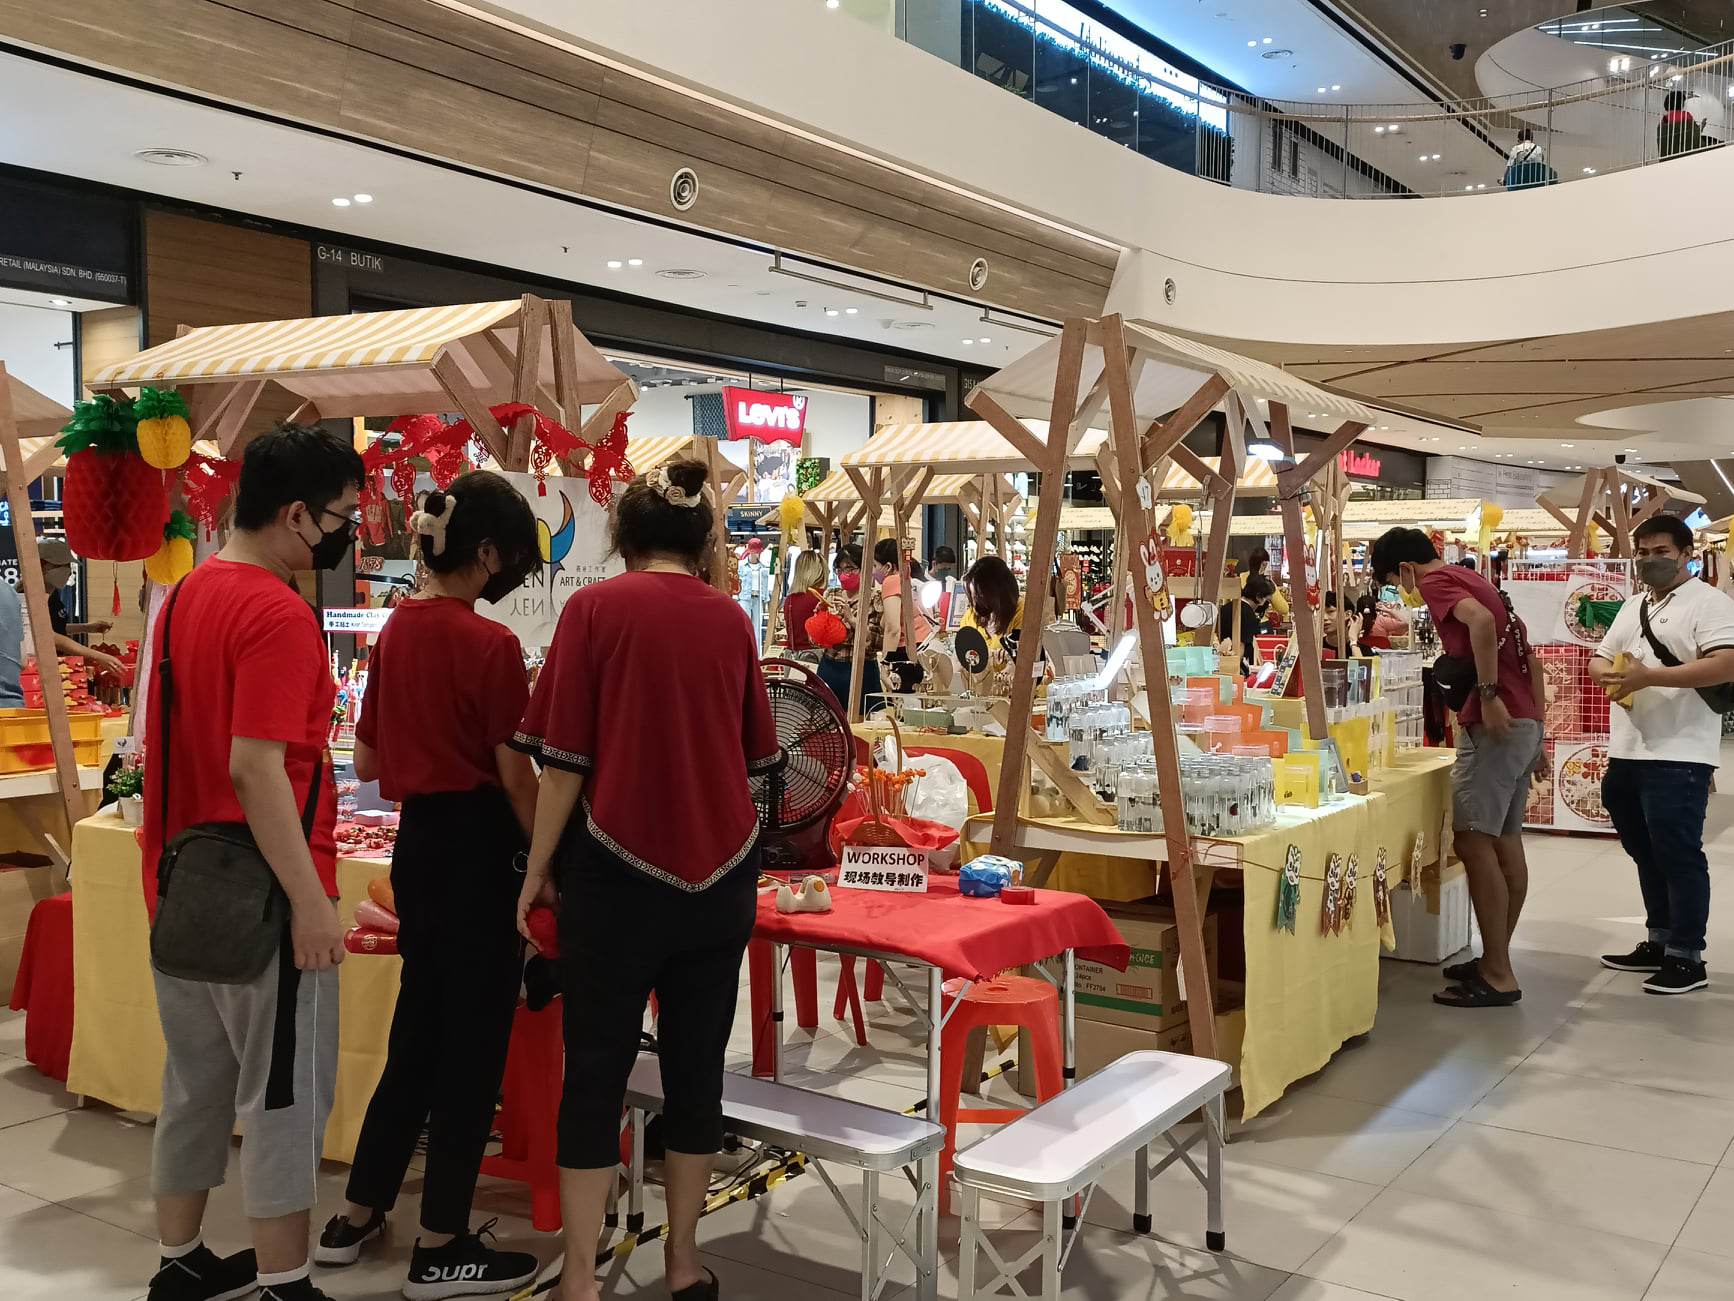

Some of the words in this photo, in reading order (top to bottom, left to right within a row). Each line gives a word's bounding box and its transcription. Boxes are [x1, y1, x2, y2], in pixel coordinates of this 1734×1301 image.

[317, 246, 342, 261] G-14
[350, 252, 381, 270] BUTIK
[0, 257, 22, 269] RETAIL
[23, 261, 61, 275] (MALAYSIA)
[560, 577, 575, 587] ART
[576, 577, 581, 587] &
[847, 852, 924, 866] WORKSHOP
[844, 871, 924, 887] 现场教导制作
[1074, 964, 1104, 974] ONTAINER
